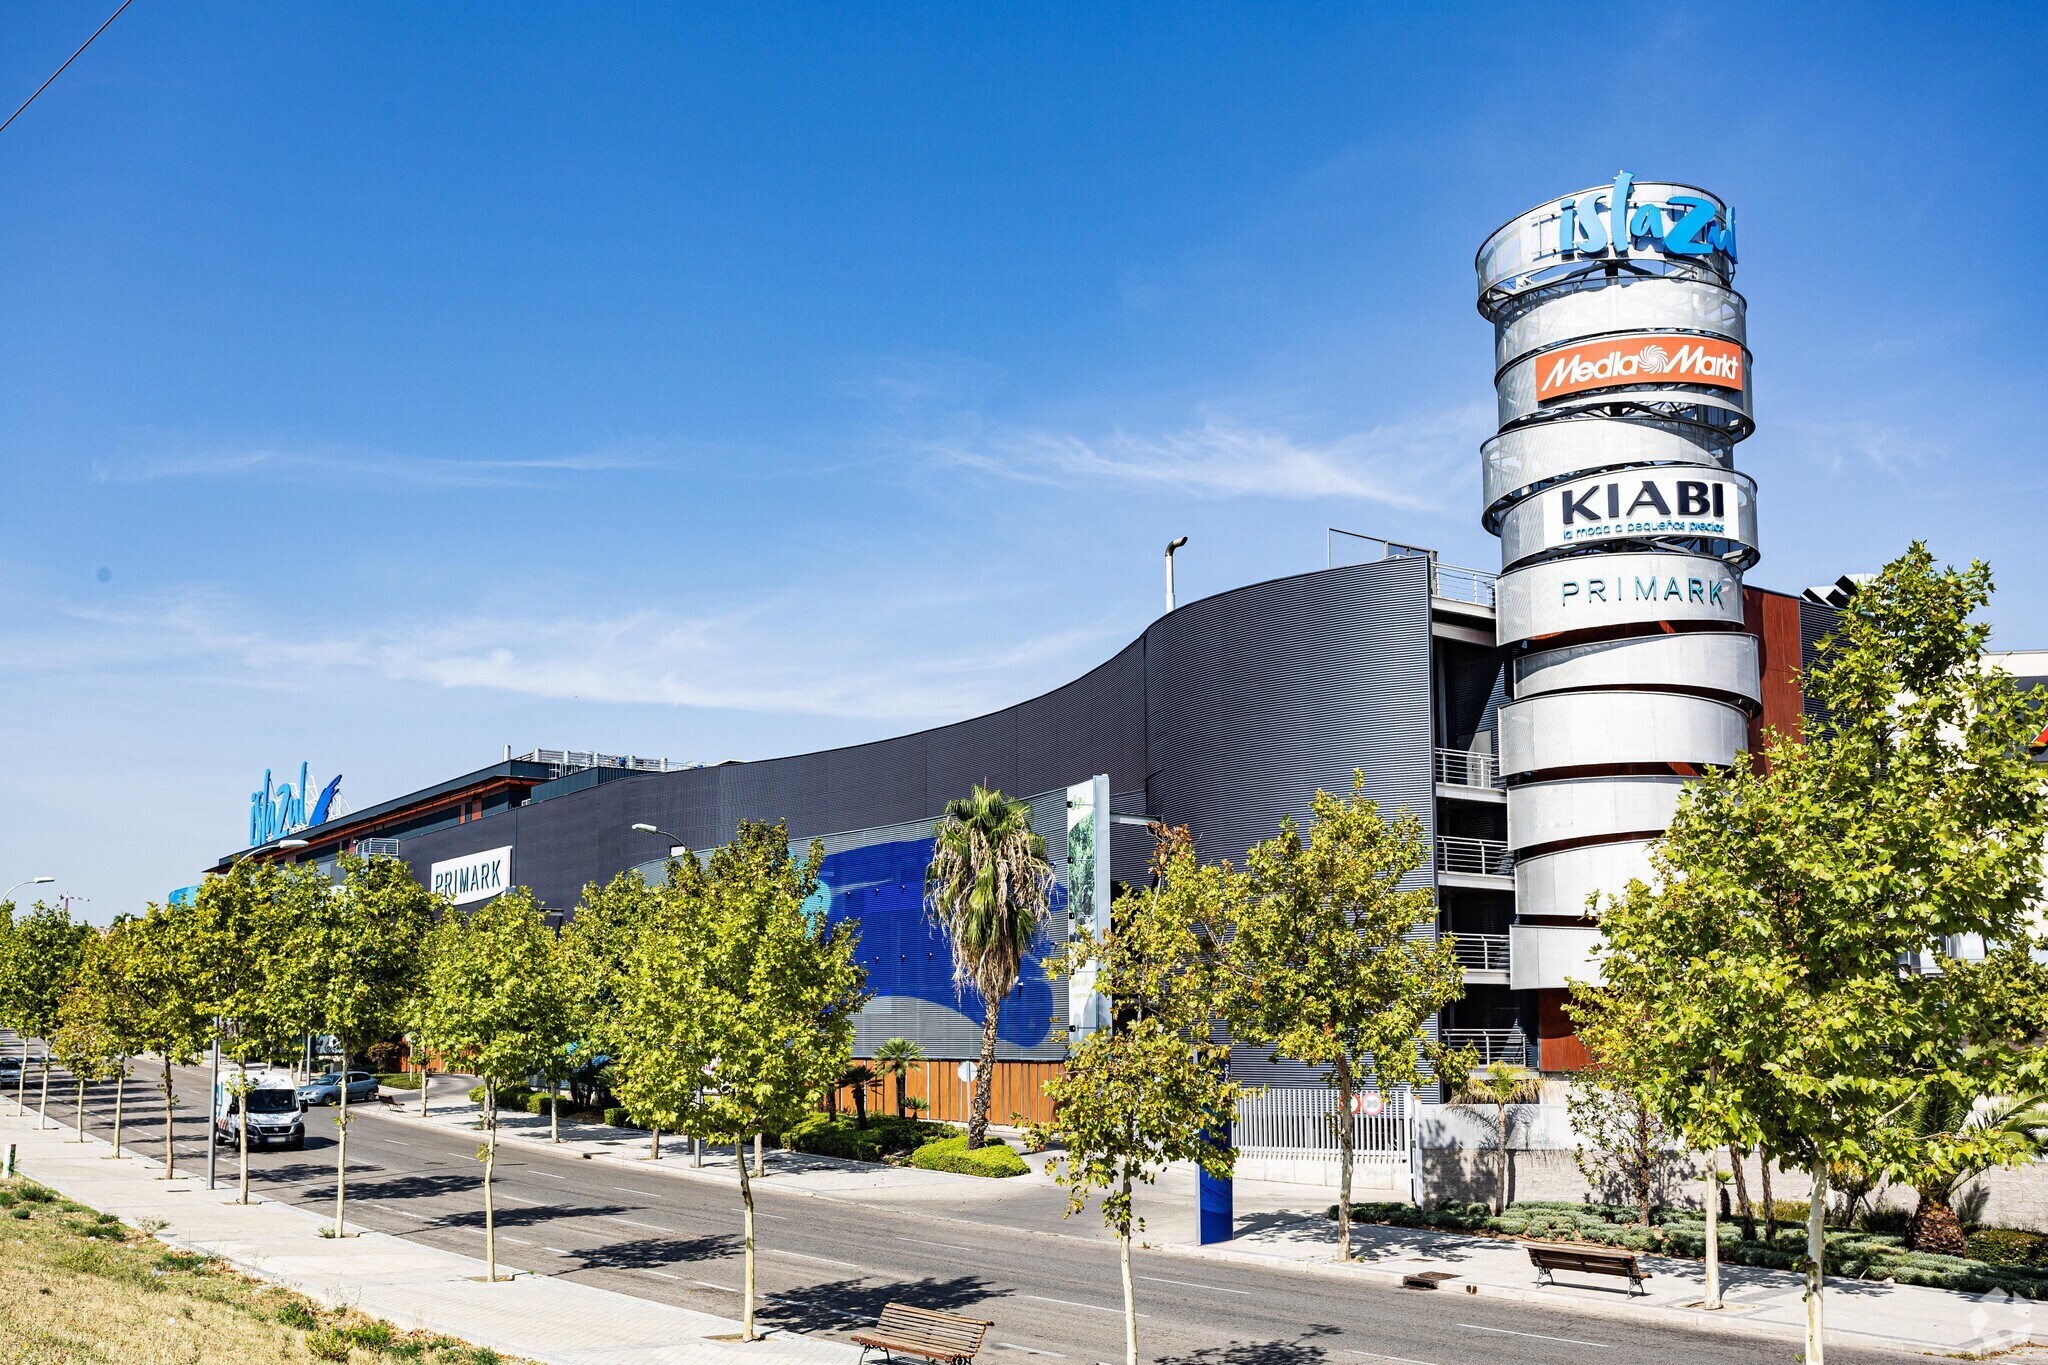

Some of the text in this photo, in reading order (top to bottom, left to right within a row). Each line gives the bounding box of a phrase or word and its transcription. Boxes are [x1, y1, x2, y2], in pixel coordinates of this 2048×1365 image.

[1562, 480, 1725, 525] KIABI
[1563, 520, 1725, 541] la moda a pequeños precios
[1562, 575, 1725, 608] PRIMARK
[435, 859, 501, 897] PRIMARK
